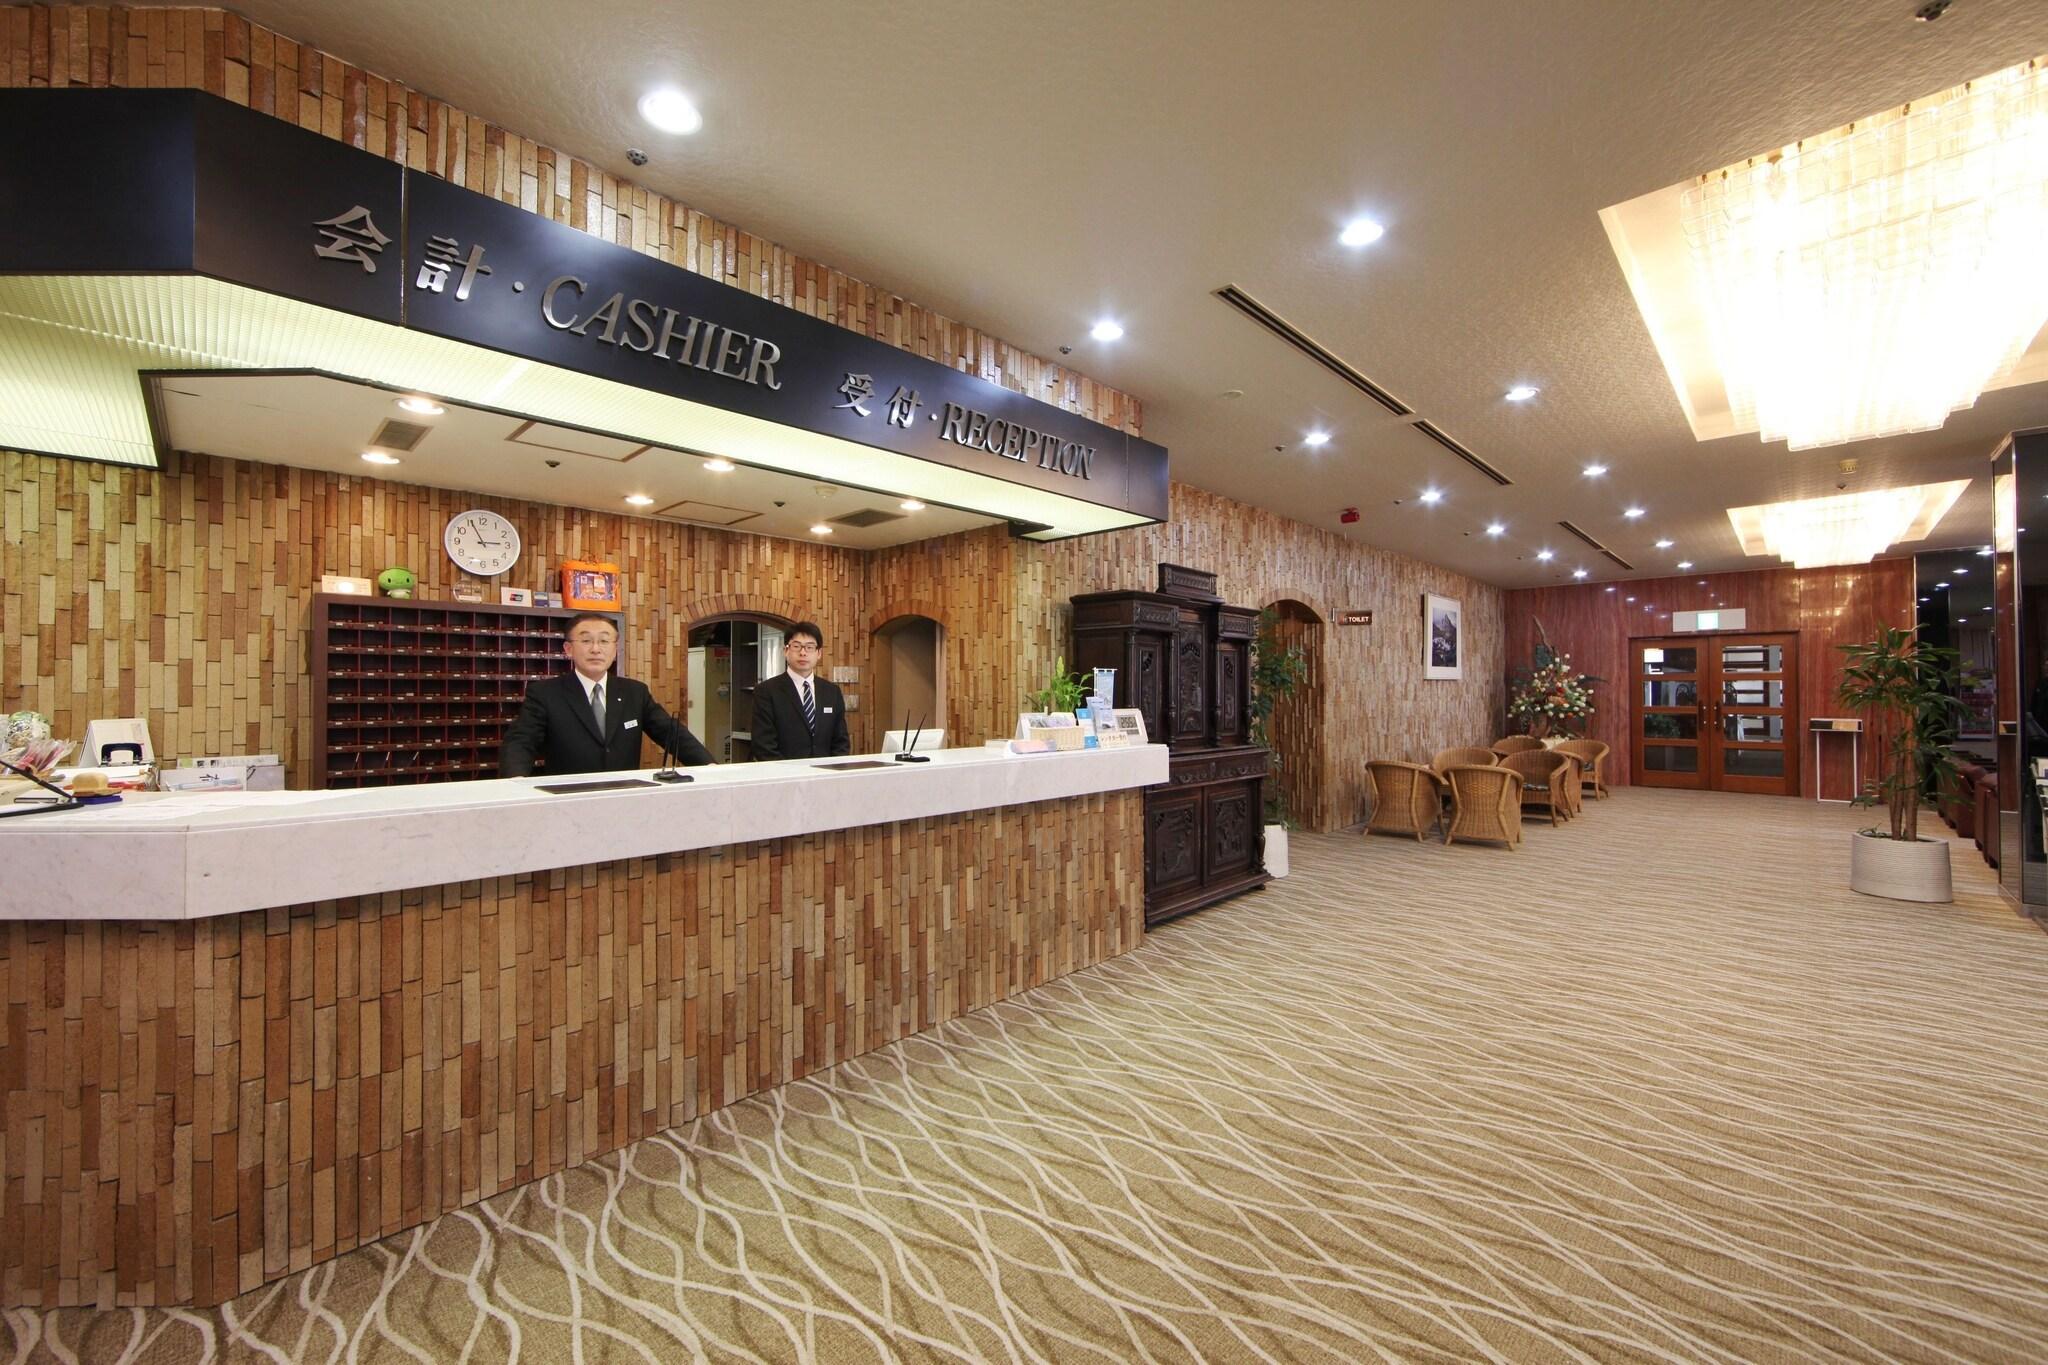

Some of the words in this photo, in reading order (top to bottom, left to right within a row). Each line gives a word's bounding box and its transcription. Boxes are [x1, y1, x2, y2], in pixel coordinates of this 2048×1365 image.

[541, 274, 782, 391] CASHIER
[832, 372, 924, 429] 受付
[939, 401, 1097, 480] RECEPTION
[478, 518, 488, 526] 12
[457, 526, 467, 536] 10
[454, 537, 460, 545] 9
[504, 542, 511, 550] 3
[480, 560, 486, 568] 6
[492, 558, 499, 566] 5
